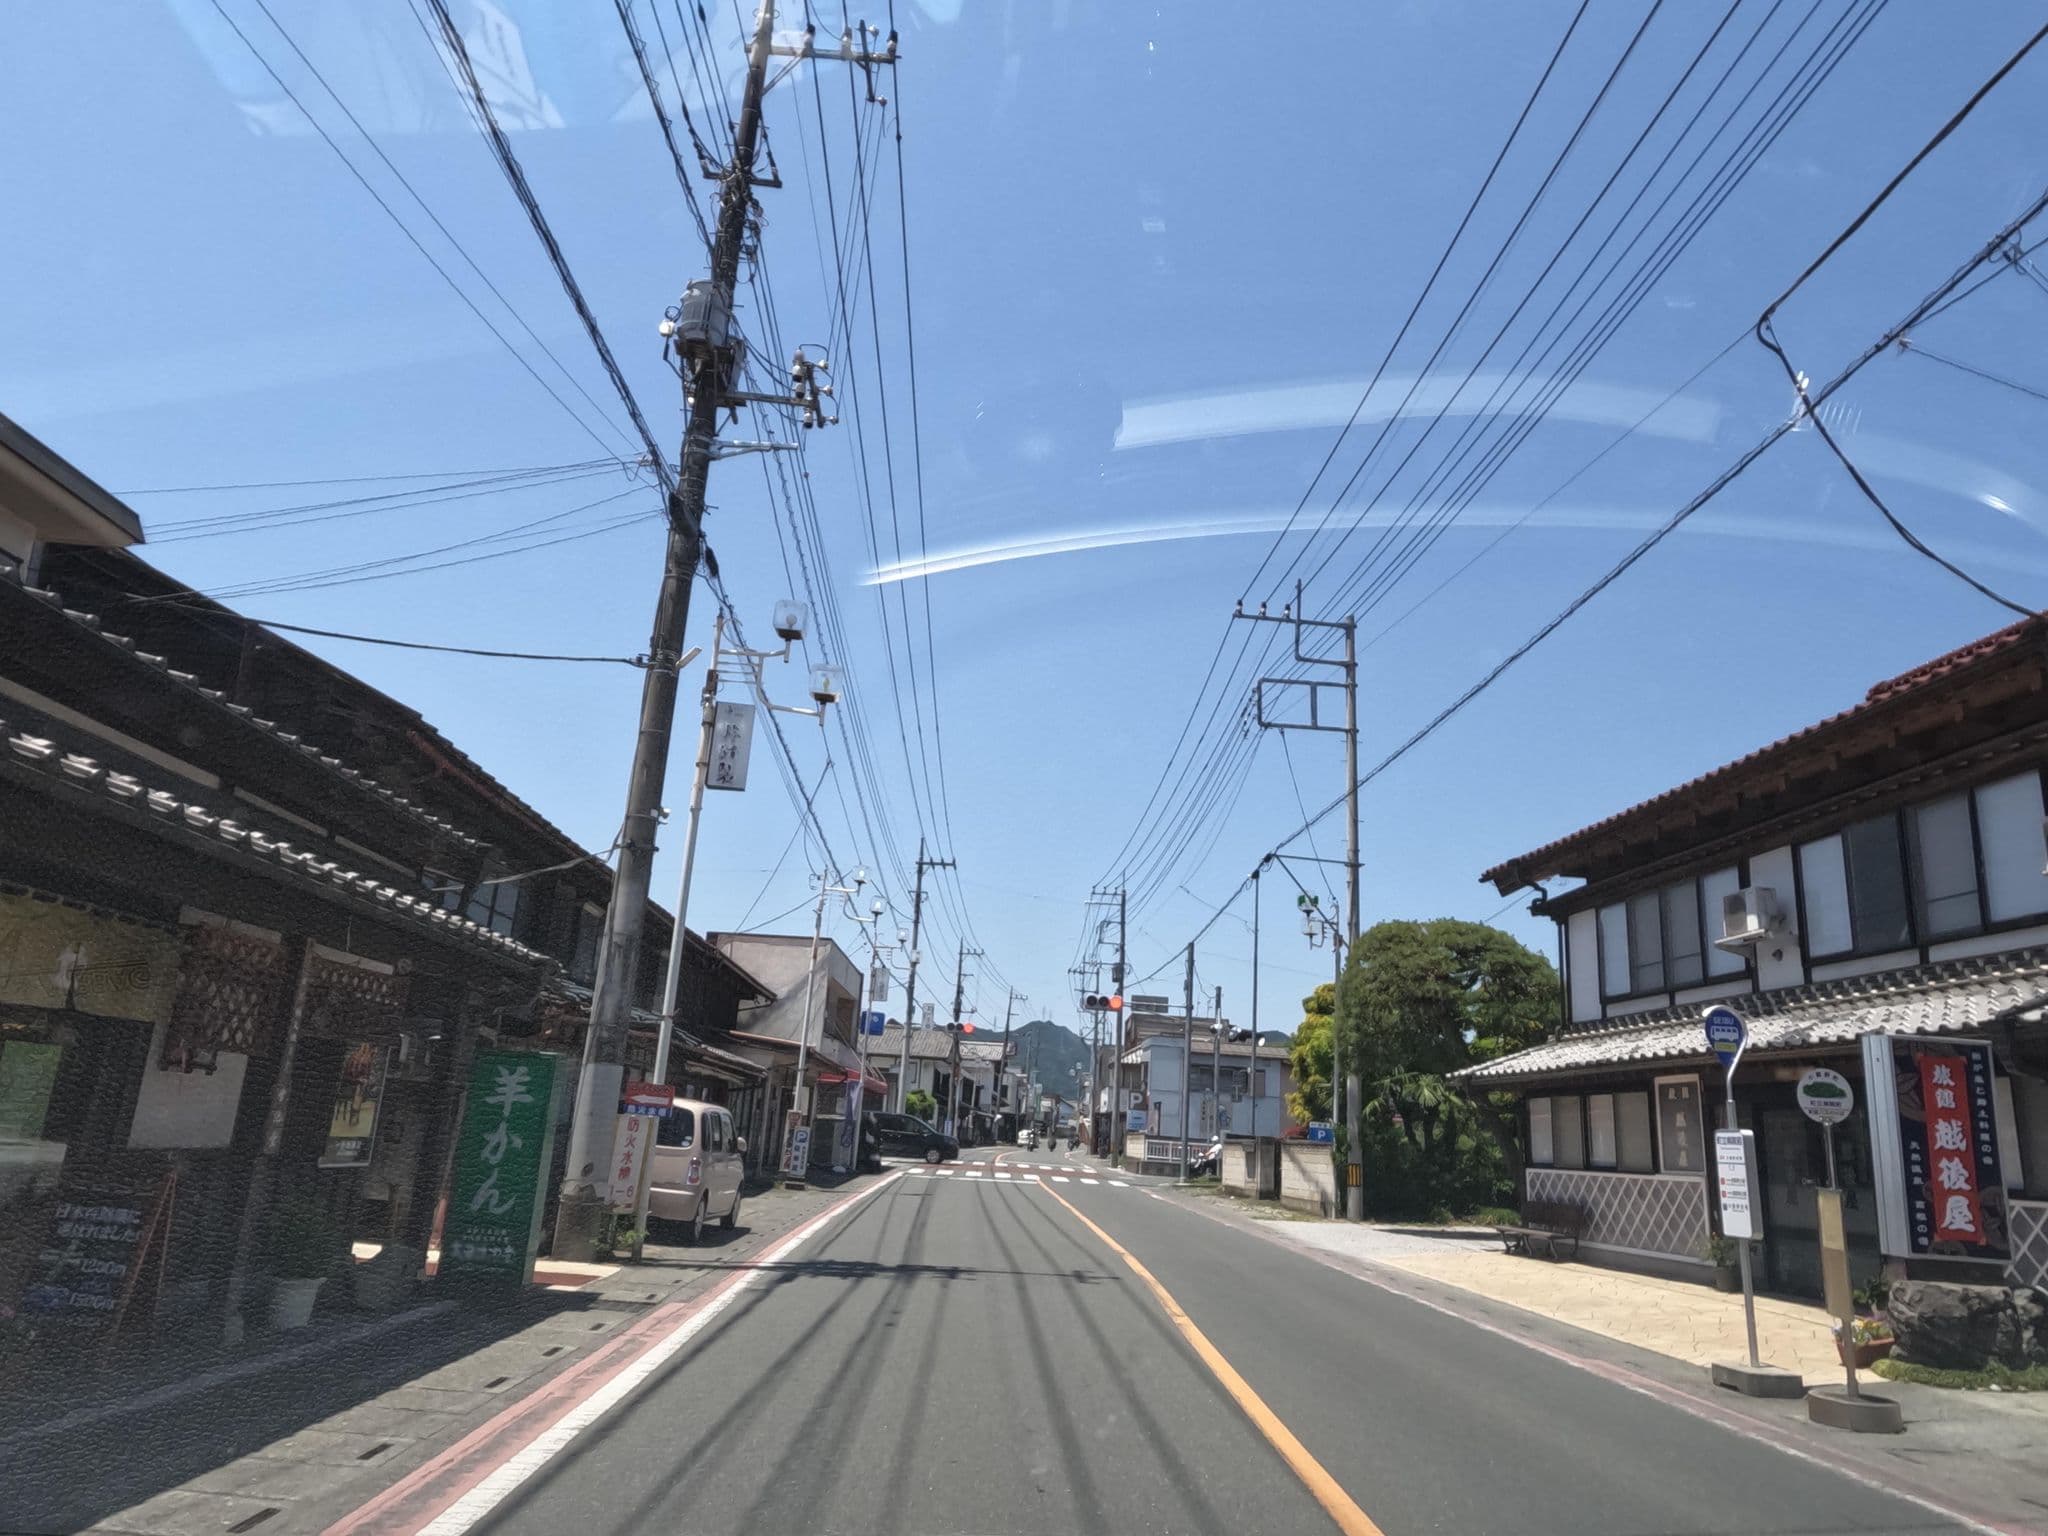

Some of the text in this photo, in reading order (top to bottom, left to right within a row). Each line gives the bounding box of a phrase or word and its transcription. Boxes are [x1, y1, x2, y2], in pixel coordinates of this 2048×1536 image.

[1130, 1092, 1144, 1110] P
[469, 1065, 535, 1215] 羊かん
[617, 1116, 640, 1180] 防火水槽
[1317, 1130, 1326, 1140] P
[1935, 1118, 1977, 1233] 越後屋
